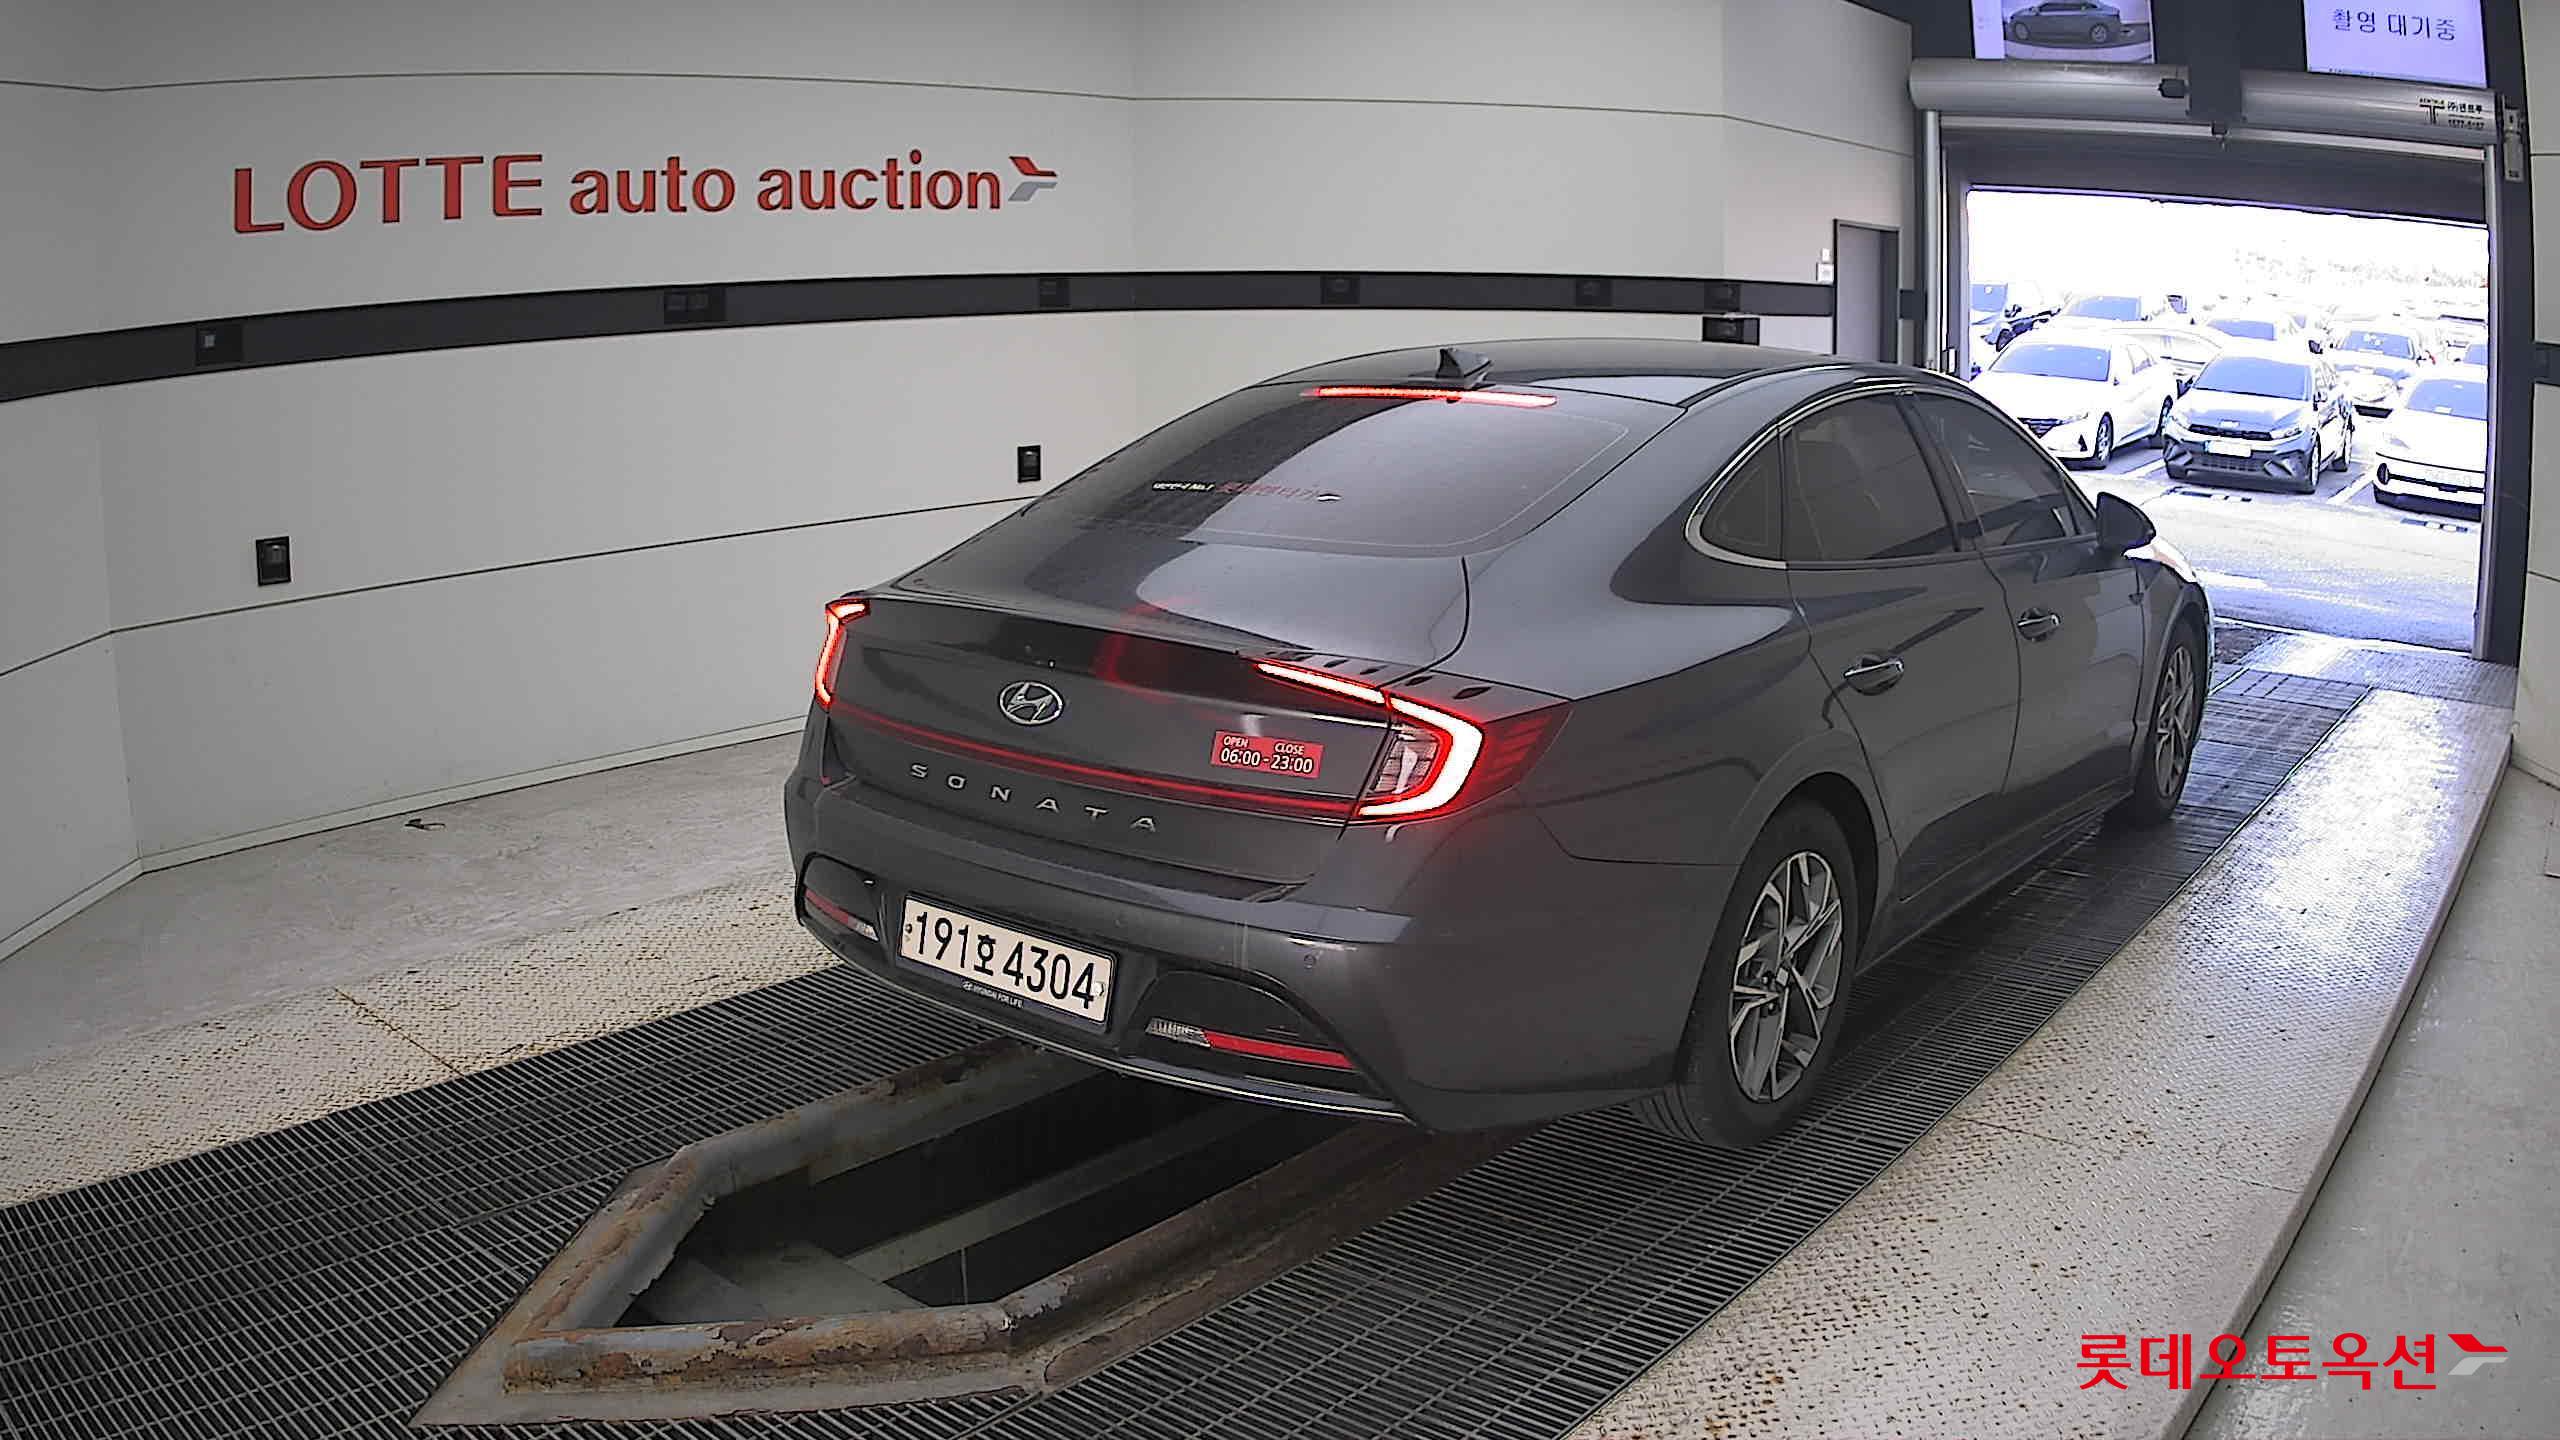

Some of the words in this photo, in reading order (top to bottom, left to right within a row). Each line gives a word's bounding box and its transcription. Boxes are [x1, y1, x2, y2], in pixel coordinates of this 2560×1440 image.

[2333, 9, 2376, 33] 촬영
[2387, 14, 2456, 41] 대기중
[234, 154, 543, 234] LOTTE
[569, 156, 736, 214] auto
[757, 149, 1001, 210] auction
[1221, 747, 1260, 766] 06:00
[1270, 754, 1313, 773] 23:00
[1223, 735, 1249, 748] OPEN
[1274, 743, 1304, 755] CLOSE
[911, 764, 1156, 832] SONATA
[916, 911, 1095, 1009] 191호4304
